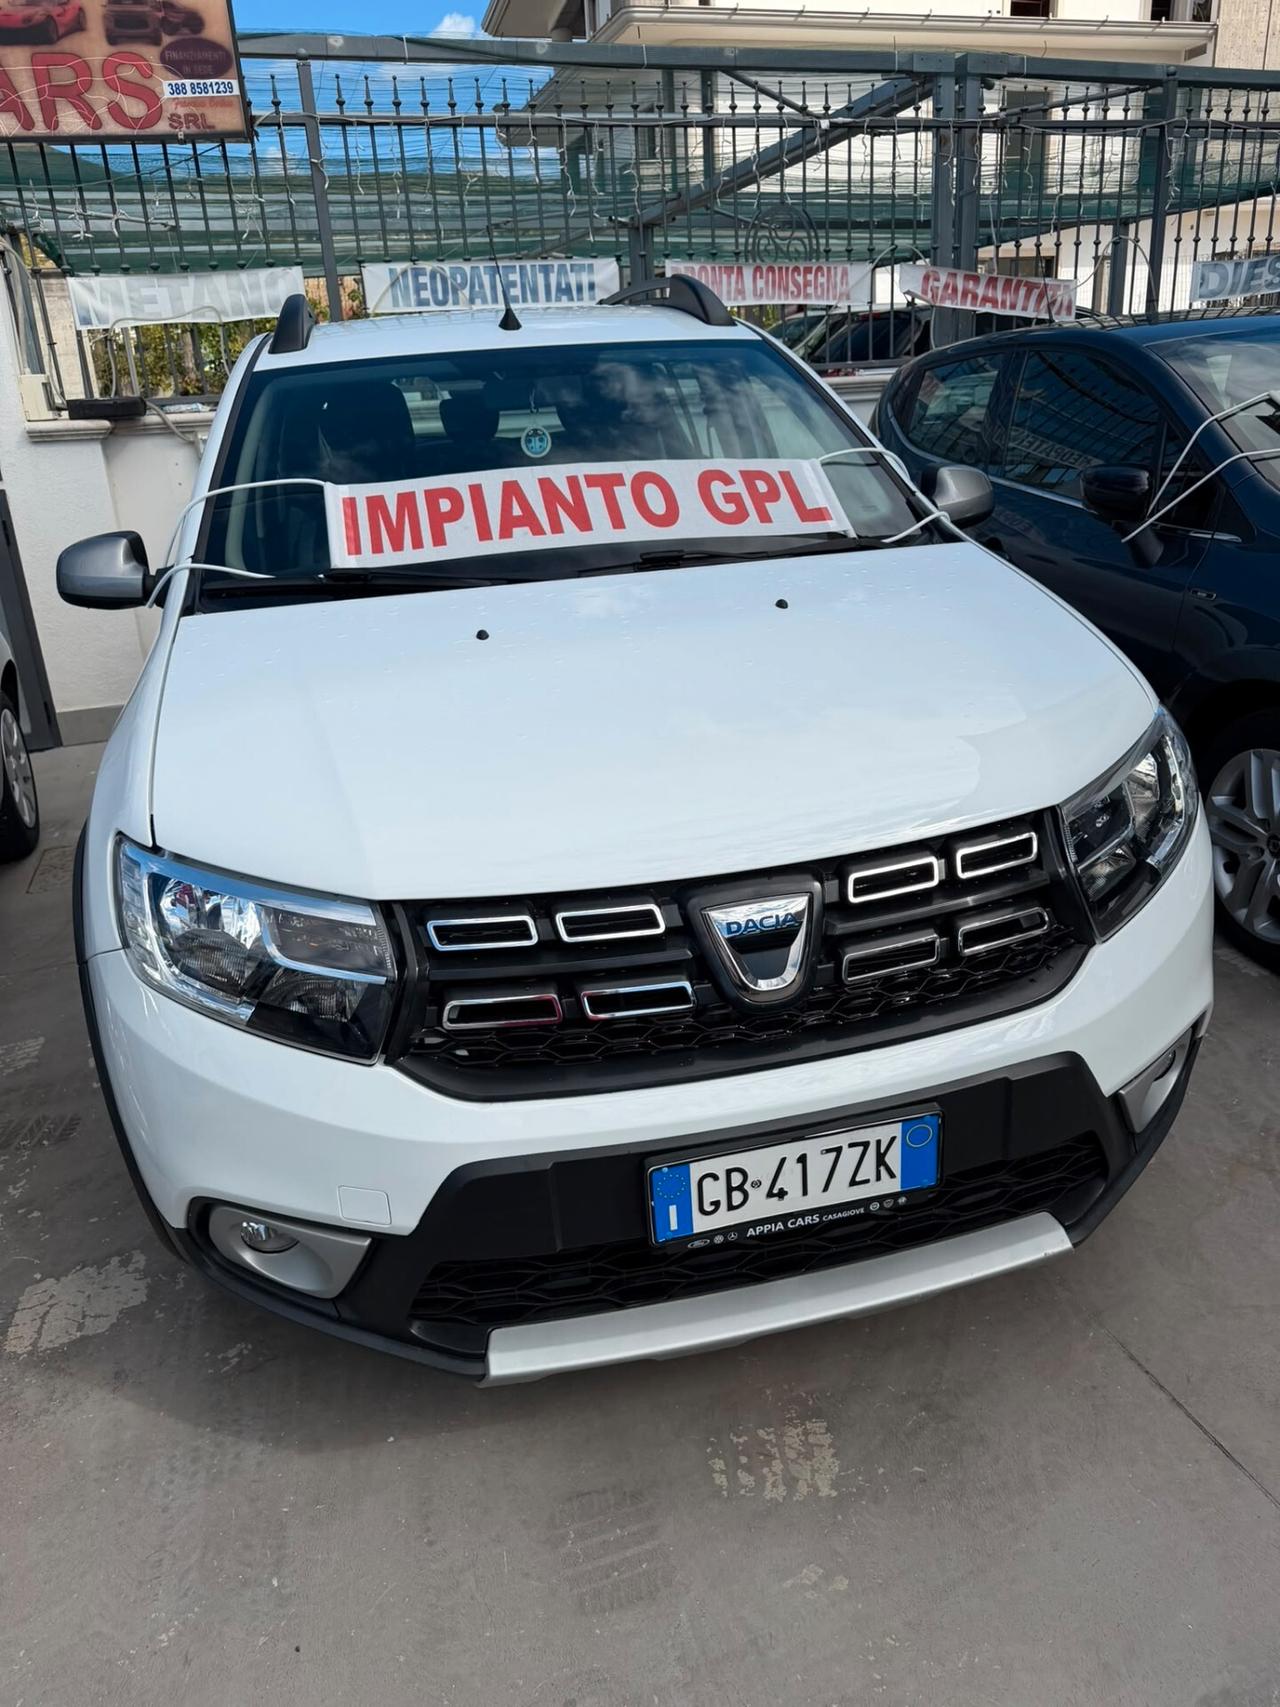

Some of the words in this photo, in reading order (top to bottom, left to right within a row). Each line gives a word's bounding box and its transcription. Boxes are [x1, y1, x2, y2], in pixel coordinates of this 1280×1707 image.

[168, 83, 187, 95] 388
[190, 82, 234, 95] 8581239
[168, 112, 216, 130] SRL
[72, 269, 302, 326] METANO
[388, 263, 597, 308] NEOPATENTATI
[752, 265, 851, 301] CONSEGNA
[920, 269, 1073, 317] GARANTITA
[342, 470, 680, 556] IMPIANTO
[697, 468, 834, 527] GPL
[725, 912, 800, 935] DACIA
[746, 1221, 785, 1237] APPIA
[787, 1213, 820, 1229] CARS
[822, 1207, 865, 1222] CASAGIOVE
